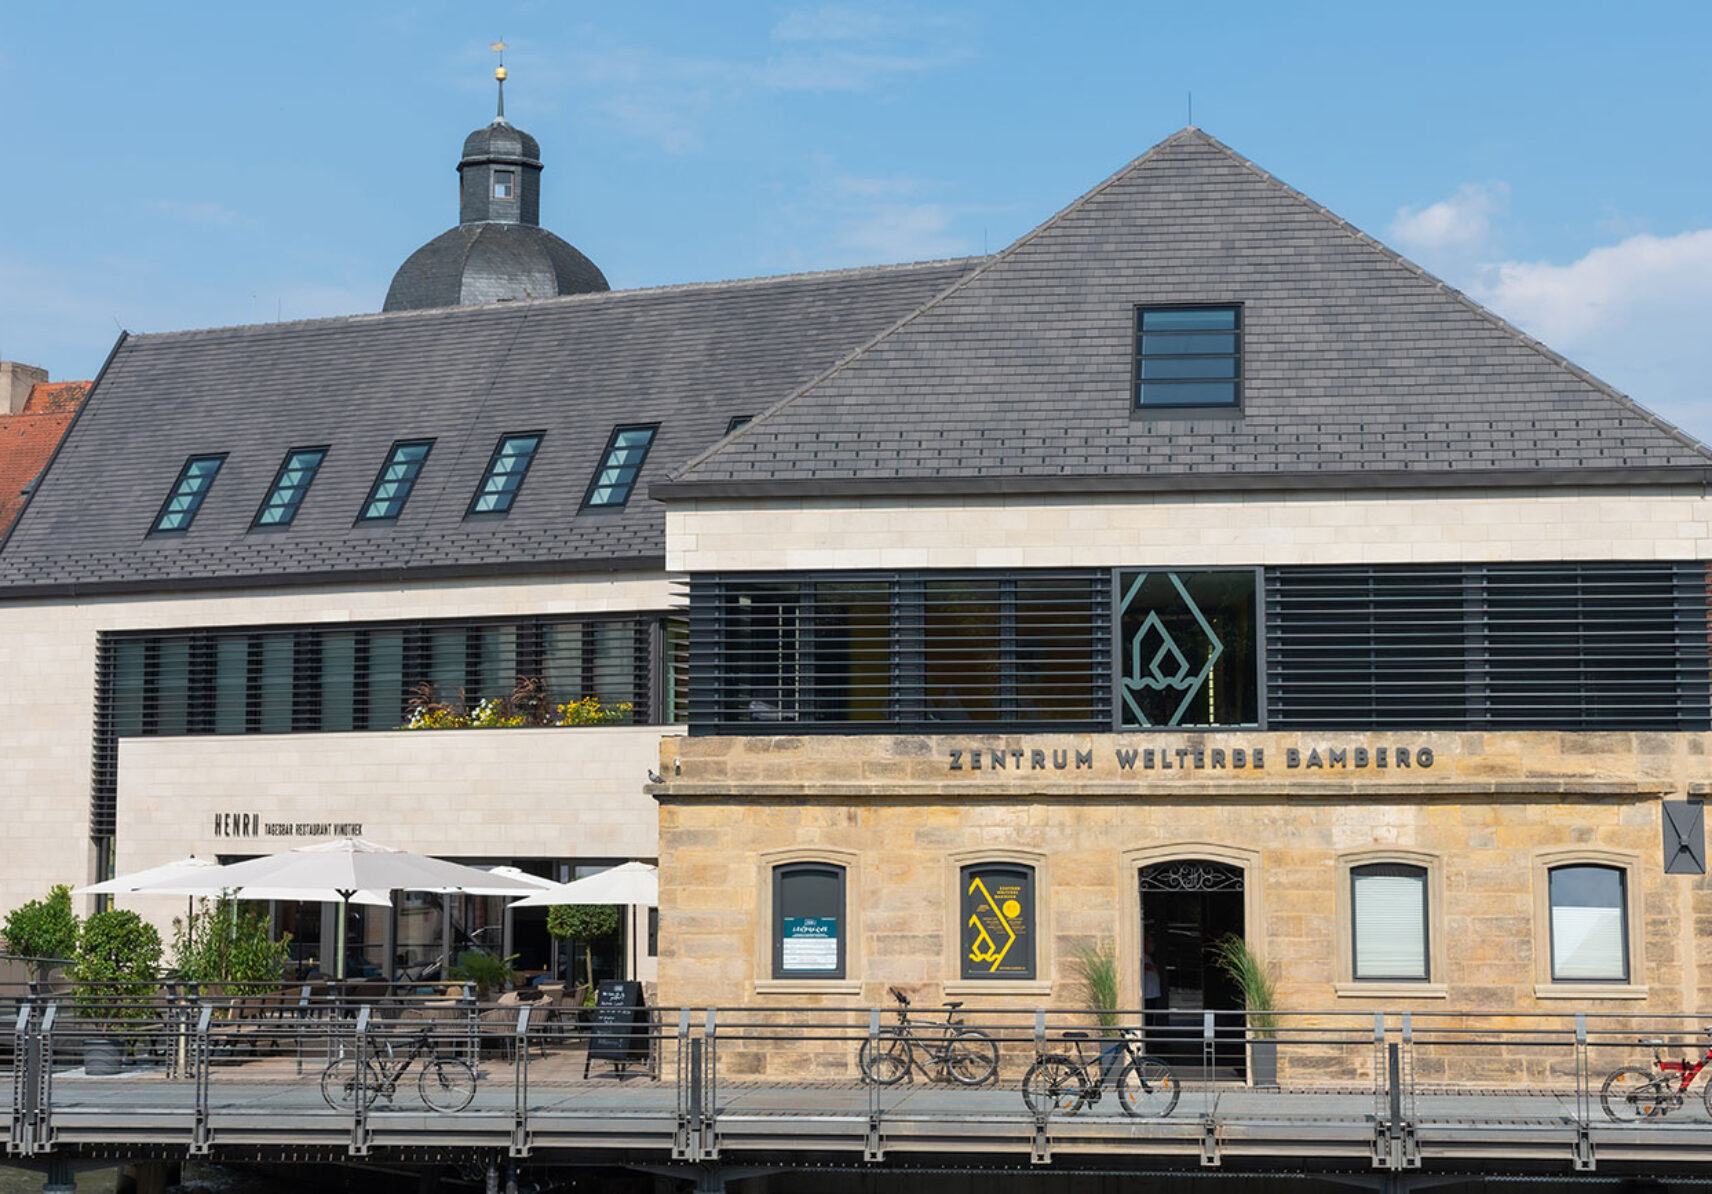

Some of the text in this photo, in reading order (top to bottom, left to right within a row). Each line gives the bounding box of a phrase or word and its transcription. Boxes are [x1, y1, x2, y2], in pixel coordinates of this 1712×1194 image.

[949, 746, 1436, 771] ZENTRUM WELTERBE BAMBERG
[295, 823, 332, 836] RESTAURANT
